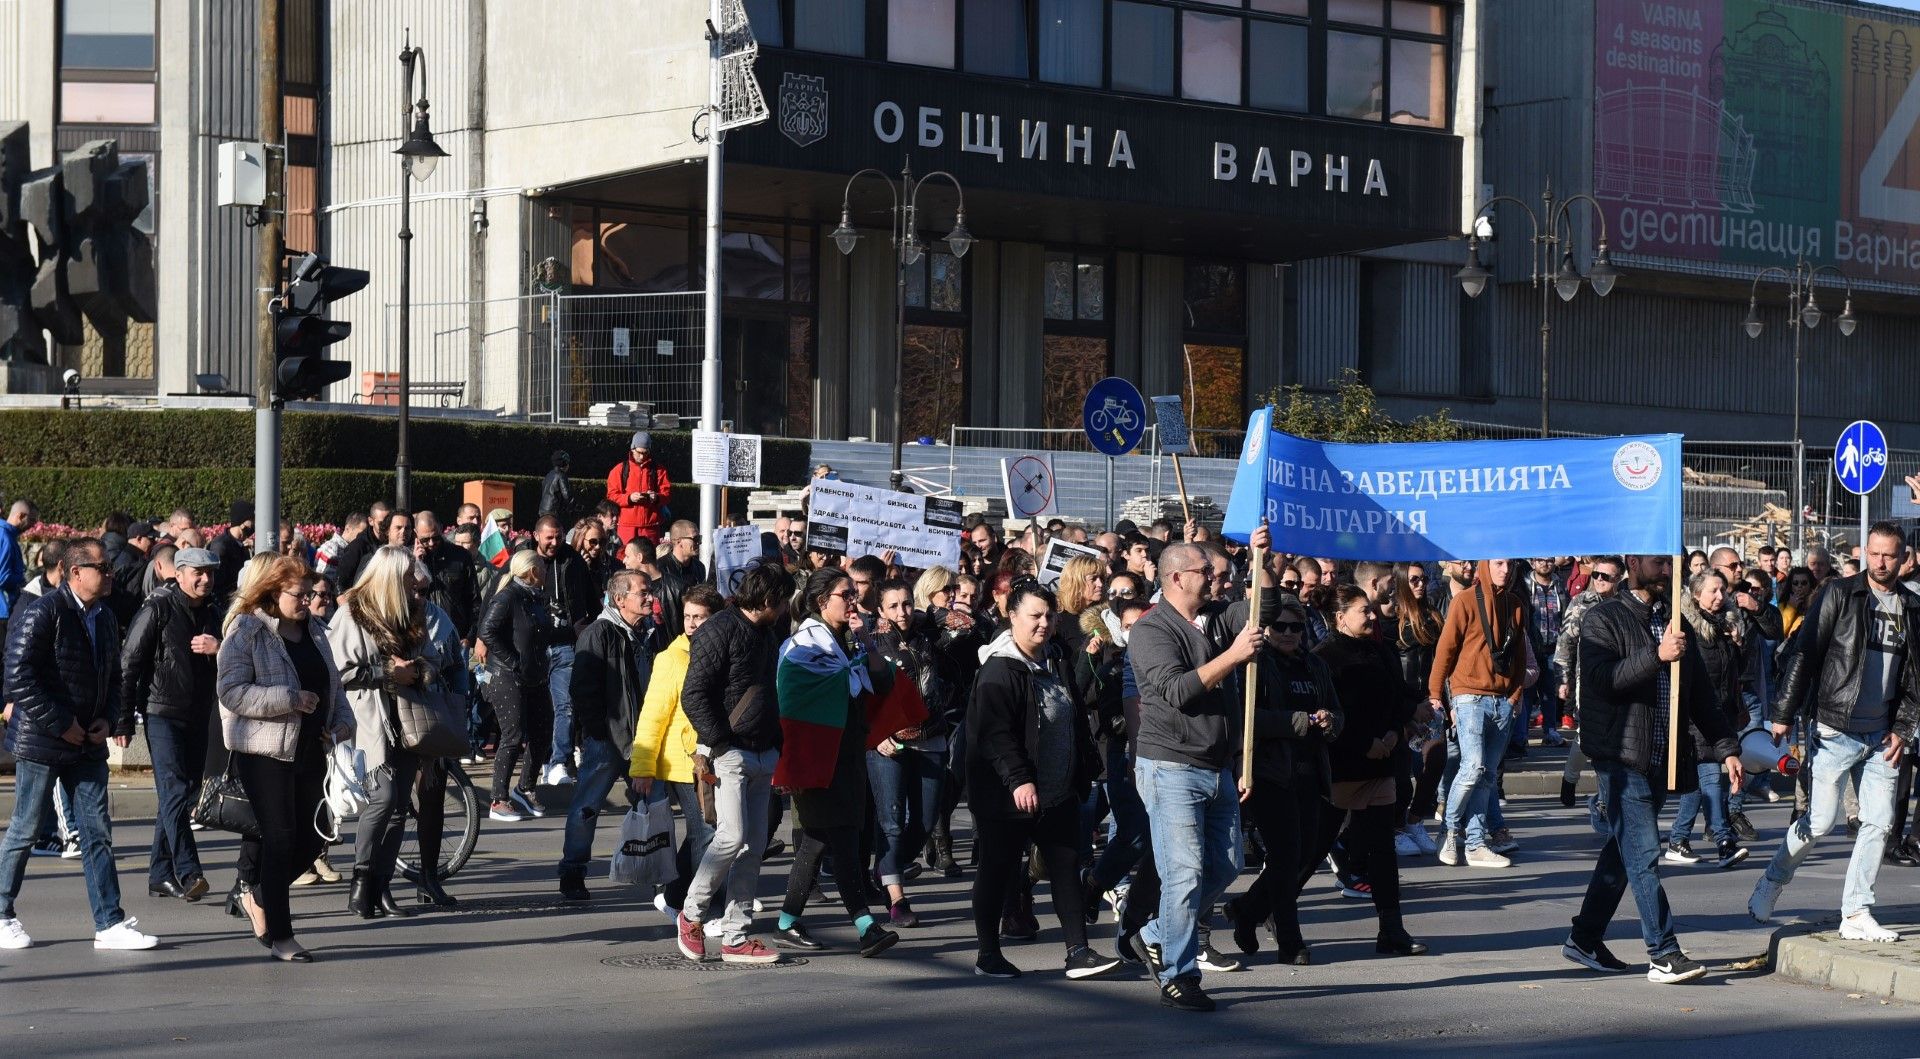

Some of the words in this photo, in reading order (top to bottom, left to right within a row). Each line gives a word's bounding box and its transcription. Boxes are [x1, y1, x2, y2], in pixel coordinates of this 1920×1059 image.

[1641, 2, 1702, 31] VARNA
[1613, 23, 1625, 44] 4
[1629, 28, 1703, 56] seasons
[1605, 46, 1702, 79] destination
[873, 100, 1137, 170] ОБЩИНА
[1213, 141, 1389, 197] ВАРНА
[1619, 205, 1821, 258] дестинация
[815, 486, 855, 498] РАВЕНСТВО
[887, 499, 917, 510] БИЗНЕСА
[1300, 466, 1336, 494] НА
[1340, 464, 1573, 500] ЗАВЕДЕНИЯТА
[813, 509, 839, 519] ЗДРАВЕ
[841, 513, 849, 521] ЗА
[928, 528, 954, 537] ВСИЧКИ
[1283, 501, 1428, 534] БЪЛГАРИЯ
